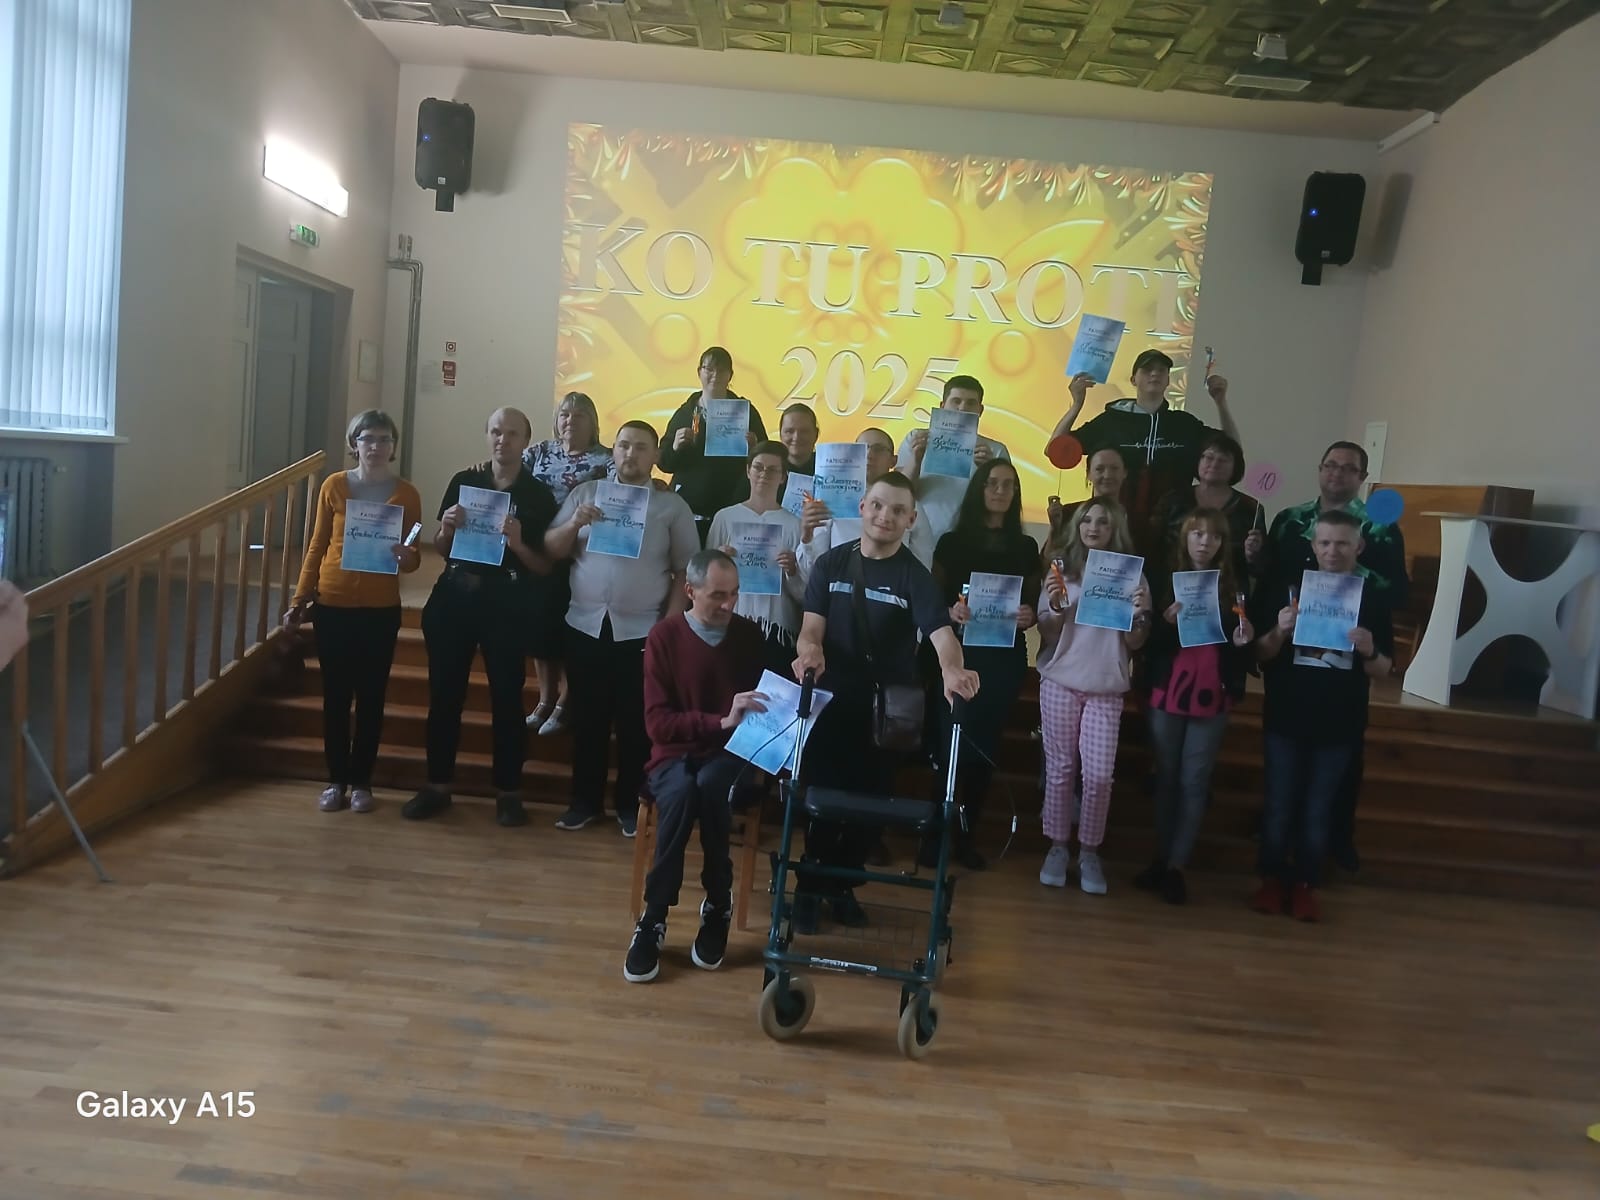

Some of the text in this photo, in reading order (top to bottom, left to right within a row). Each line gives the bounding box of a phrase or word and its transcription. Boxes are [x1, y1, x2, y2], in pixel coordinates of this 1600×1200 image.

[570, 223, 1190, 337] KO TU PROTI
[776, 346, 959, 422] 2025
[1257, 472, 1276, 491] 10
